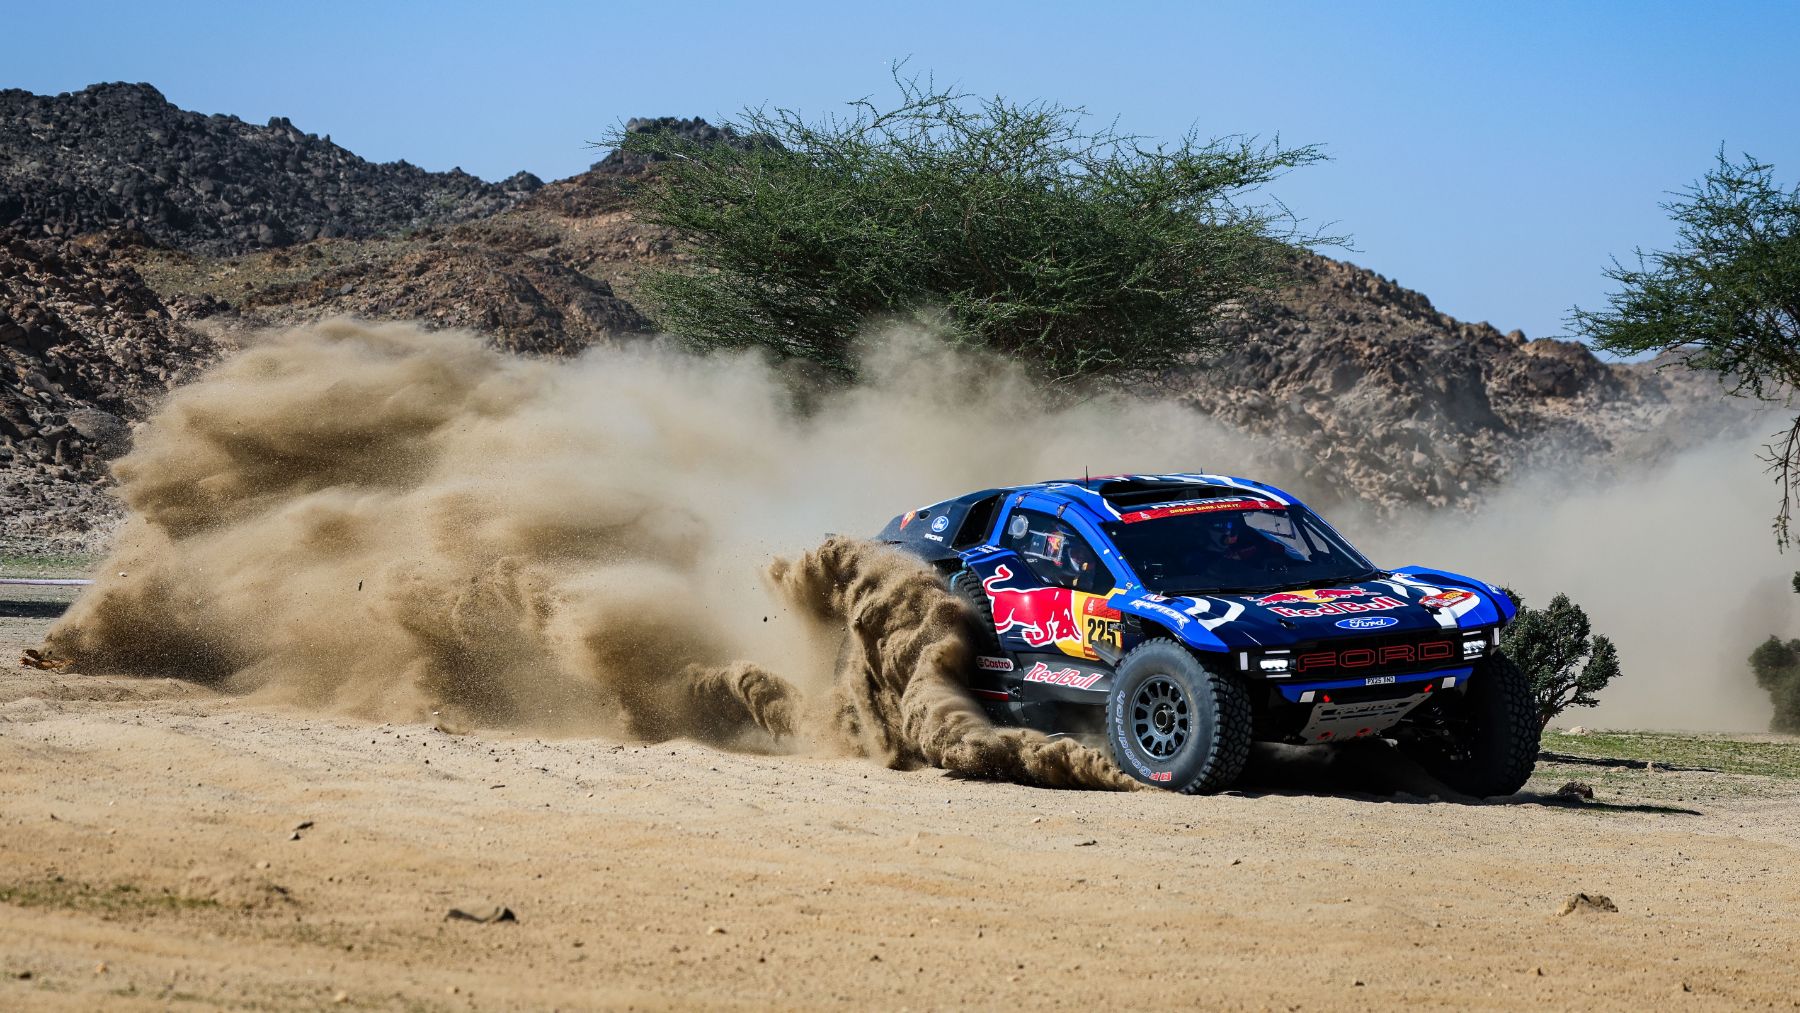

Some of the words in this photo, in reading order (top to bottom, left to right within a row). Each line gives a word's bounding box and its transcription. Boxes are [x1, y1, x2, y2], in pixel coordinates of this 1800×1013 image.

[1128, 599, 1190, 630] RAPTOR
[1350, 618, 1387, 628] Ford
[1087, 617, 1117, 647] 225
[984, 658, 1012, 669] Castrol
[1298, 641, 1454, 672] FORD
[1115, 690, 1172, 781] BFGoodrich
